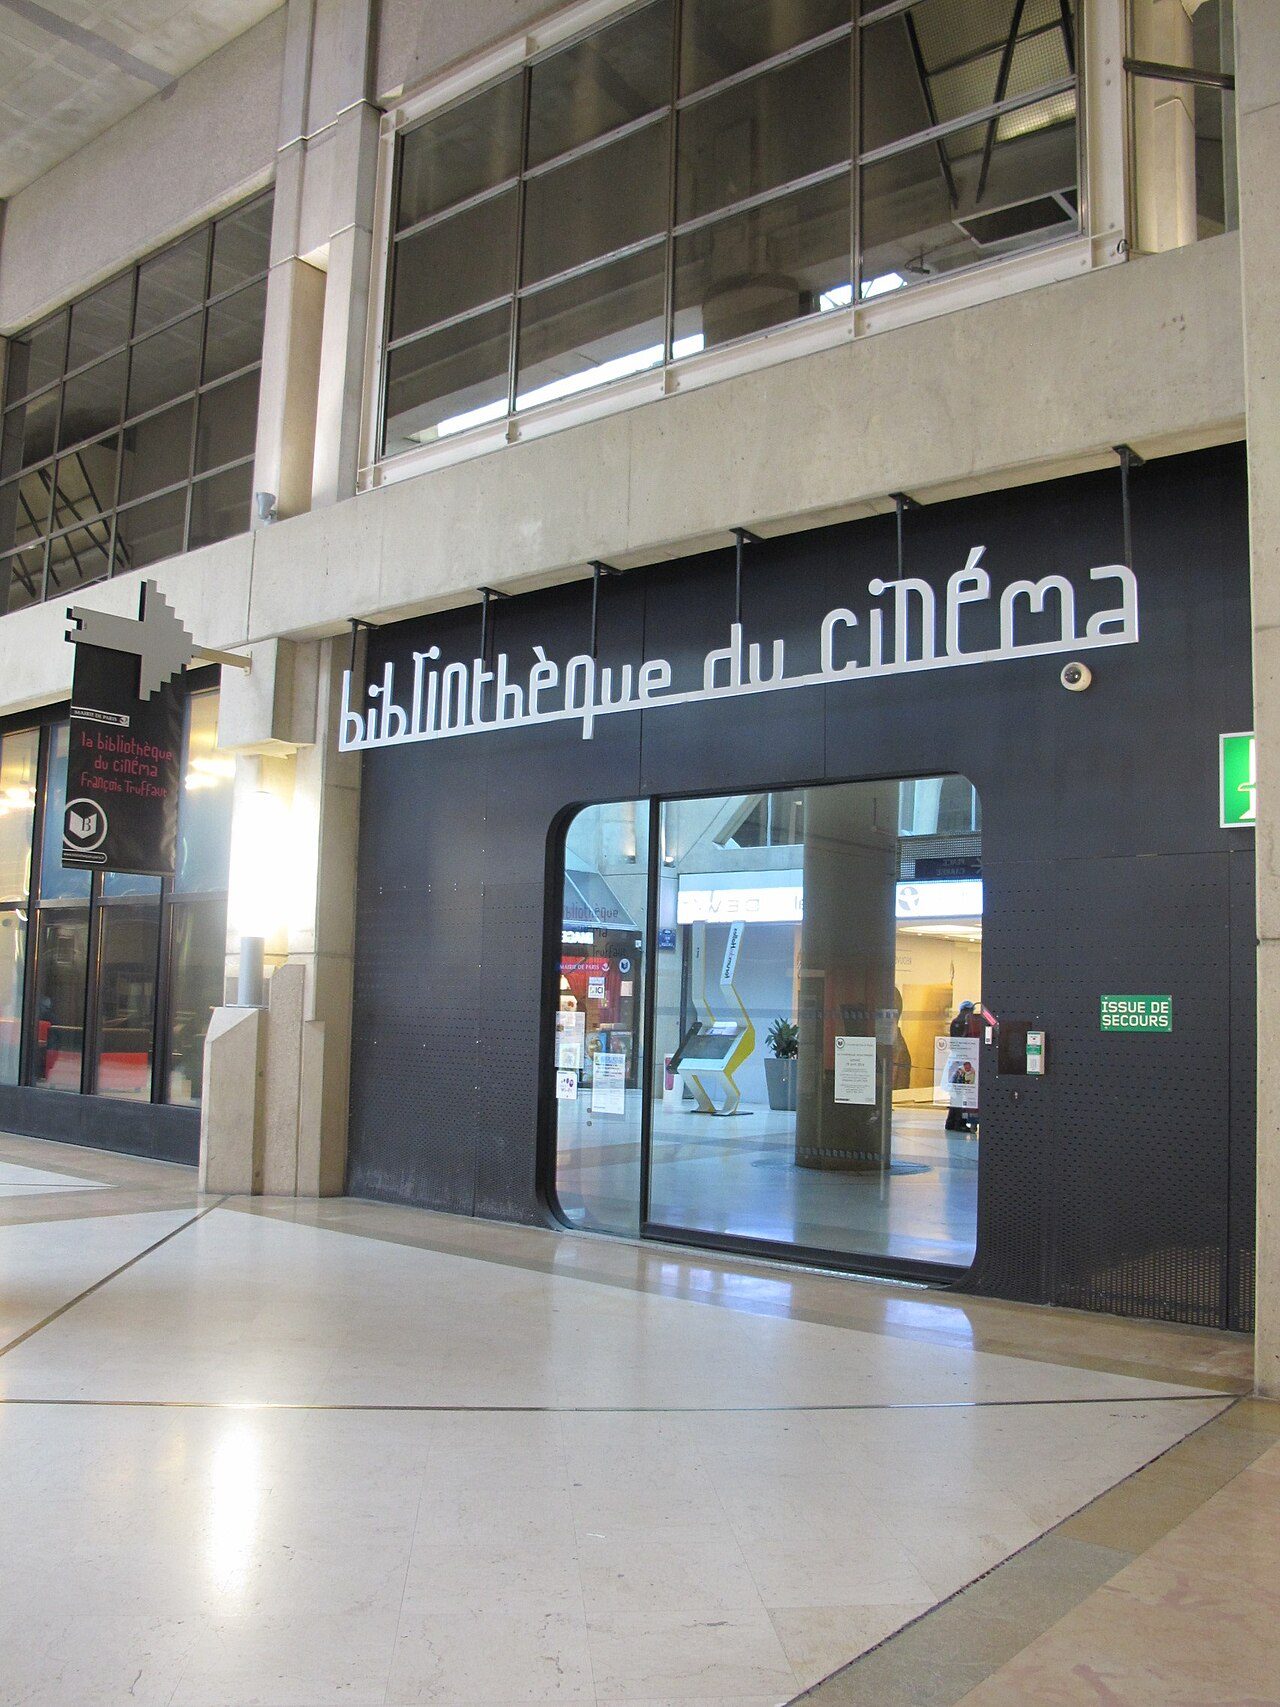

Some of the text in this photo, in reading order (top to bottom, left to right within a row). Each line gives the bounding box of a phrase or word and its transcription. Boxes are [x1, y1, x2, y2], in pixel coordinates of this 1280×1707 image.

[339, 545, 1139, 752] bibliothèque du cinéma
[81, 732, 173, 763] la bibliothèque
[94, 756, 158, 777] du cinéma
[80, 773, 169, 798] François Truffaut
[1101, 1001, 1169, 1014] ISSUE DE
[1101, 1014, 1169, 1027] SECOURS
